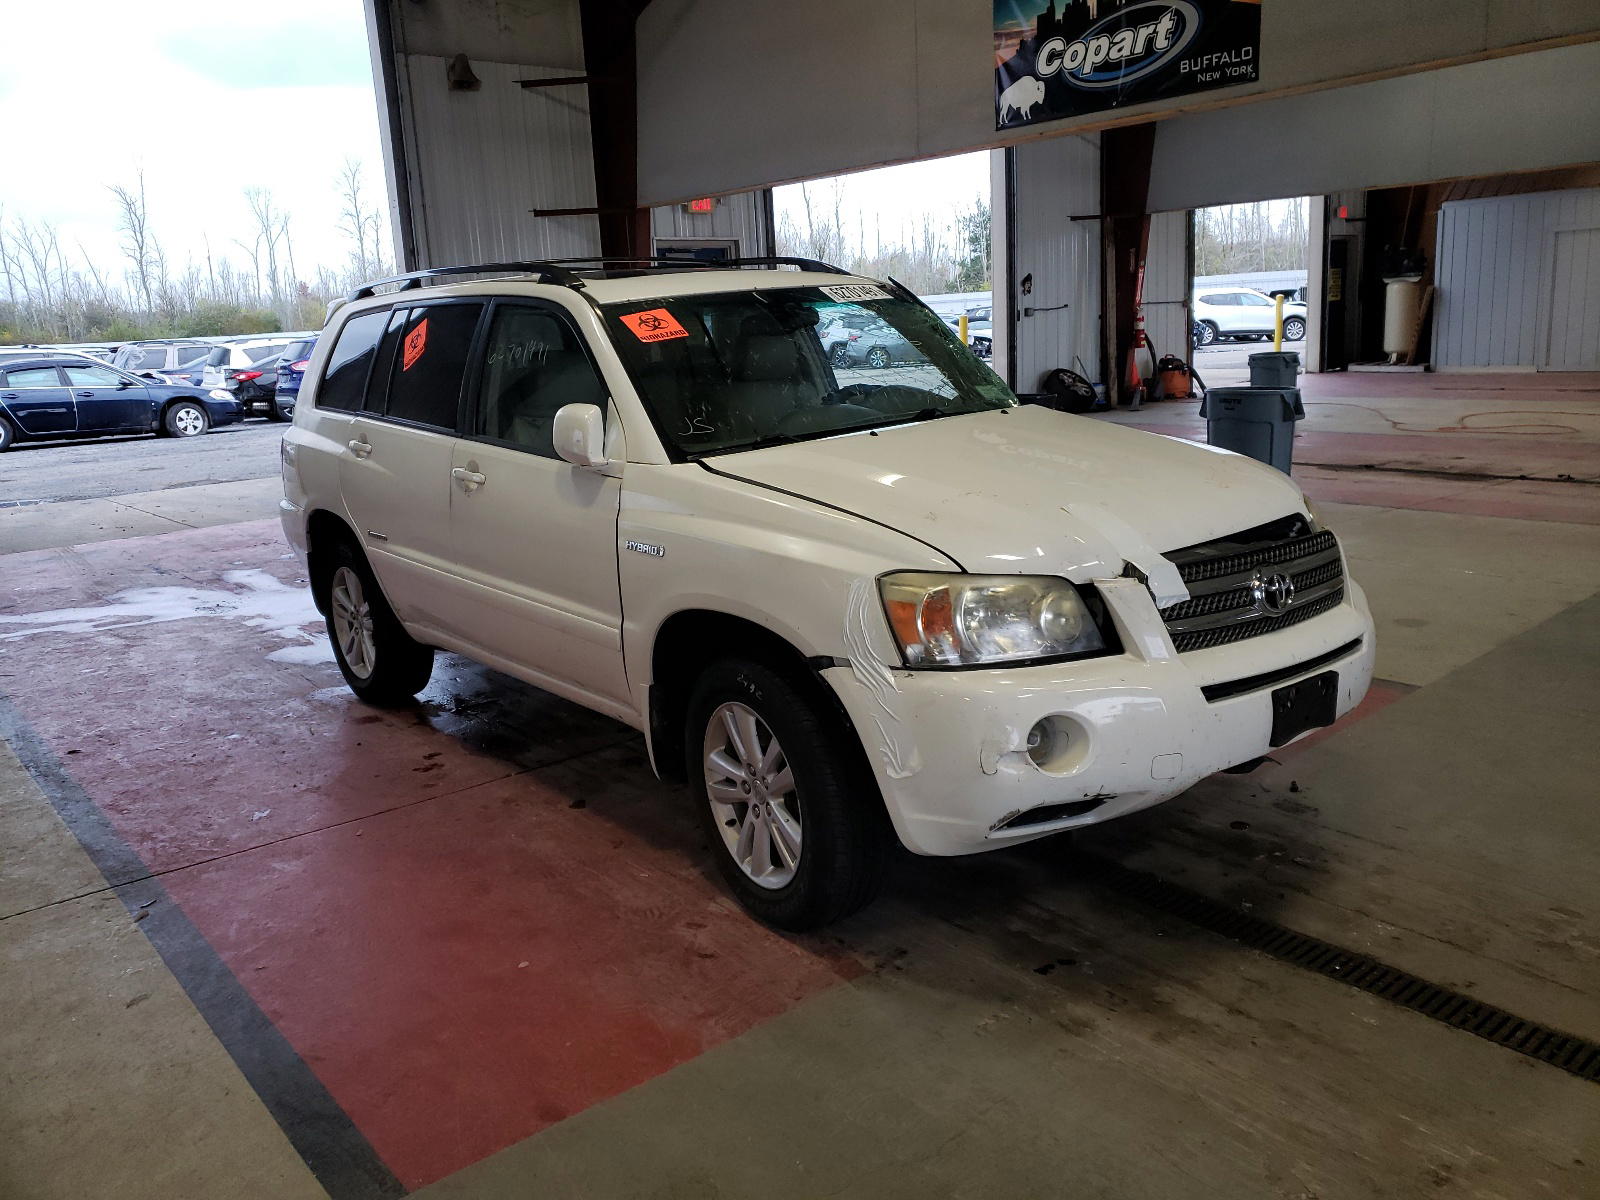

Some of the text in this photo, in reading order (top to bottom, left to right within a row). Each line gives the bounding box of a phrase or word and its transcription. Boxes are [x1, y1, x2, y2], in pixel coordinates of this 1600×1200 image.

[1035, 6, 1176, 77] Copart
[1180, 46, 1252, 73] BUFFALO
[1197, 63, 1253, 83] NEW YORK
[625, 540, 658, 556] HYBRID
